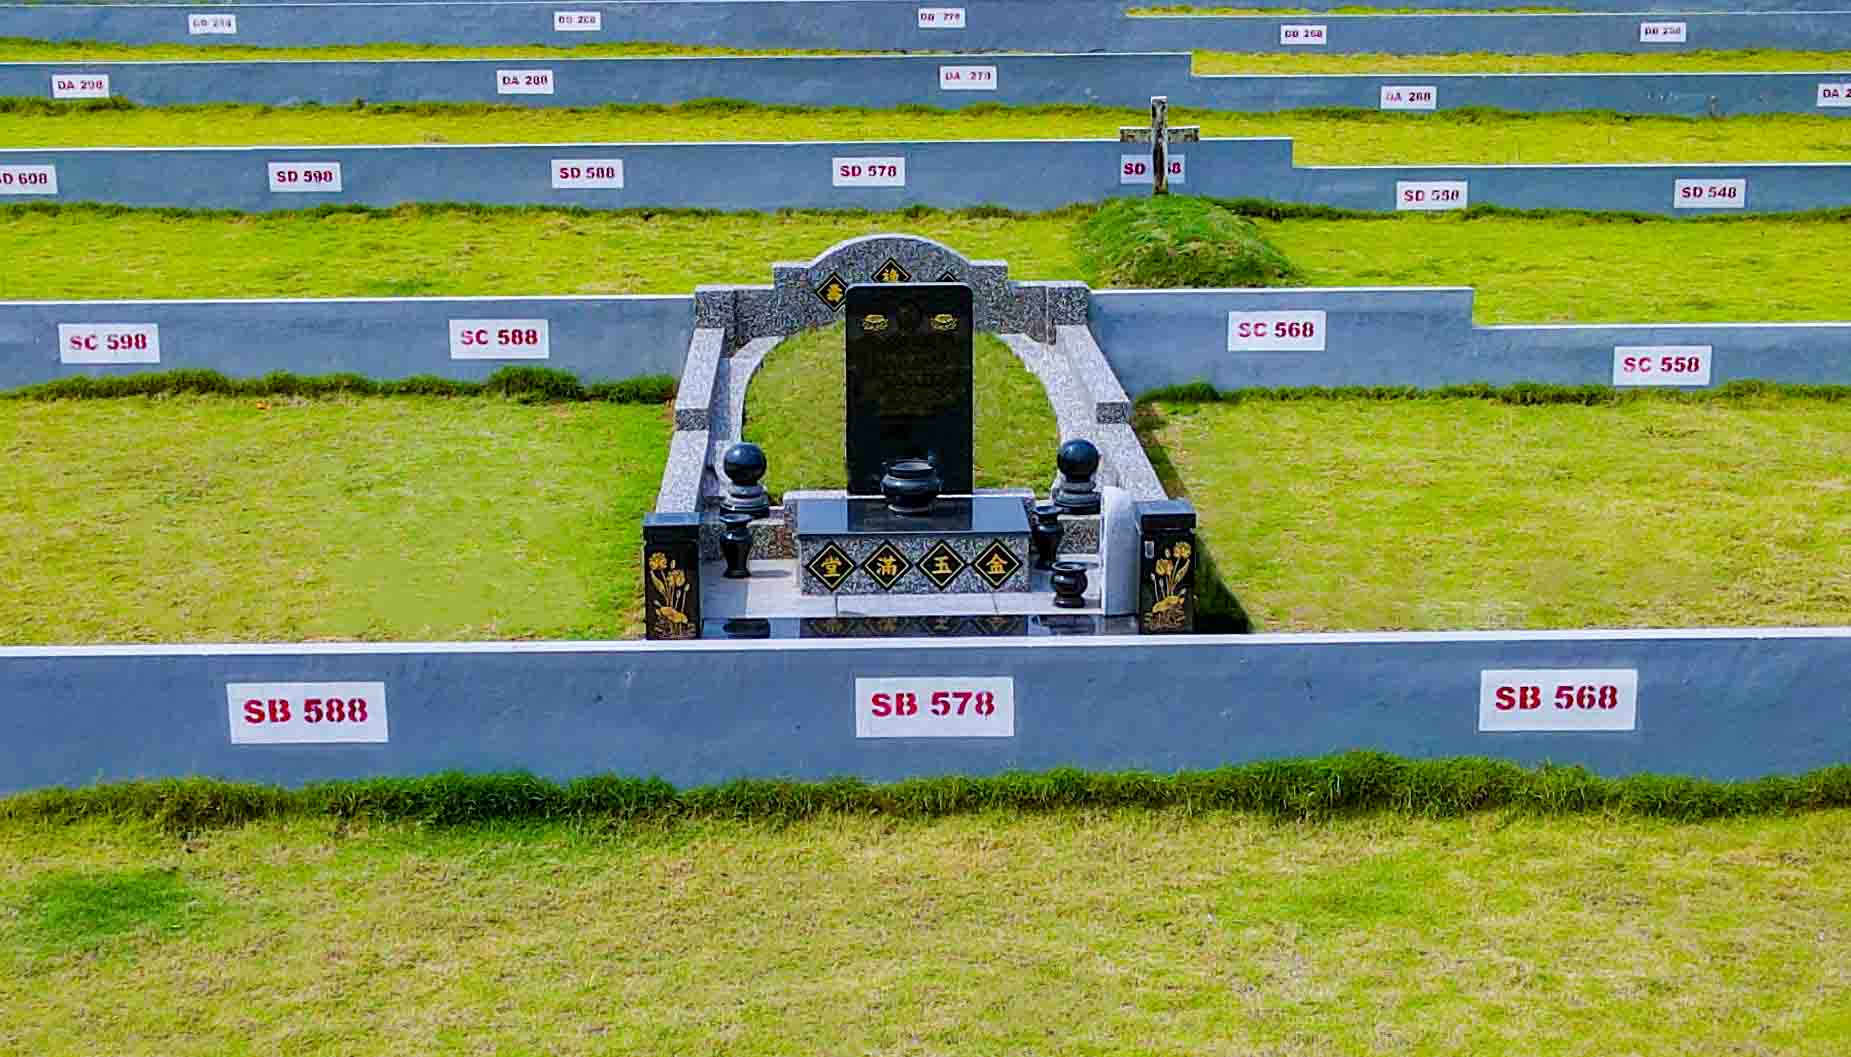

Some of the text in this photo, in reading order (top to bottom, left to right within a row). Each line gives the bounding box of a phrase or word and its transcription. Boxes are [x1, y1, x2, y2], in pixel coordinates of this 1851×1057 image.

[502, 75, 519, 86] DA
[944, 71, 960, 81] DA
[57, 79, 75, 91] DA
[1822, 88, 1839, 99] DA
[559, 166, 616, 180] SD 588
[839, 164, 897, 177] SD 578
[1124, 162, 1146, 175] SD
[0, 172, 48, 185] D 608
[276, 170, 333, 183] SD 598
[1404, 189, 1424, 202] SD
[1681, 186, 1737, 199] SD 548
[1238, 321, 1315, 338] SC 568
[70, 333, 147, 351] SC 598
[461, 328, 538, 346] SC 588
[1623, 356, 1700, 373] SC 558
[871, 691, 995, 718] SB 578
[1495, 685, 1618, 711] SB 568
[243, 697, 368, 725] SB 588
